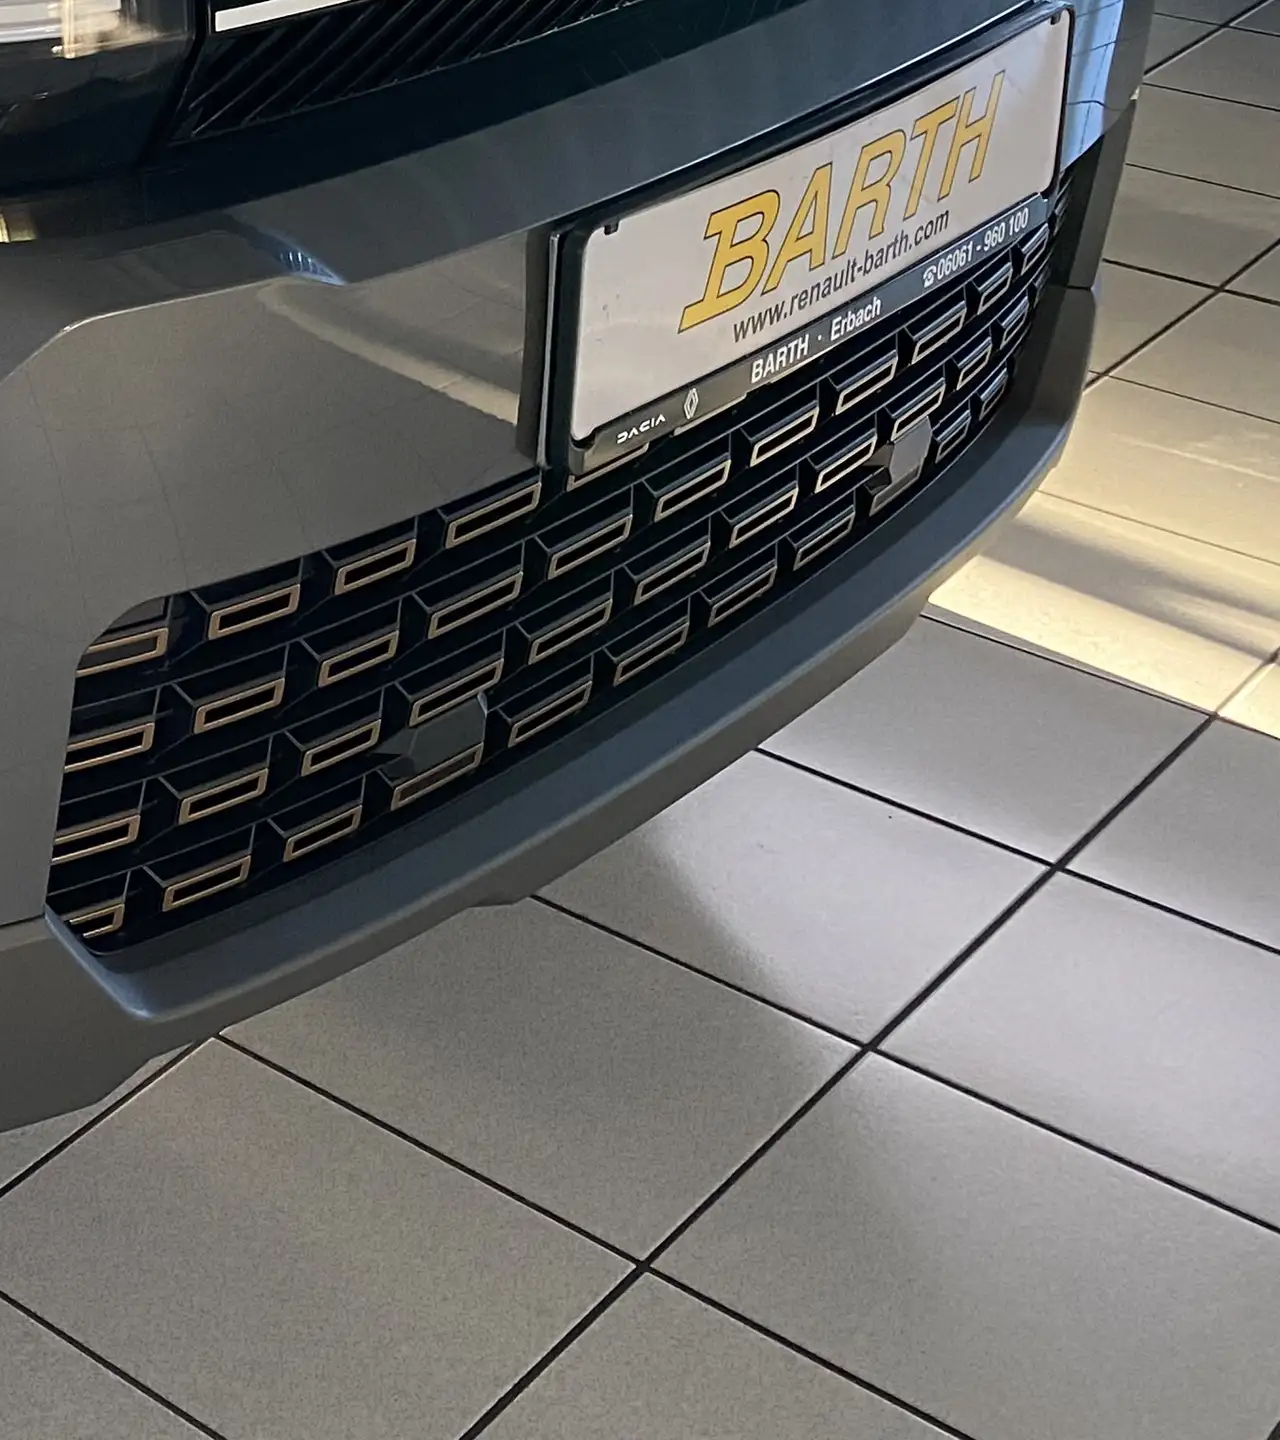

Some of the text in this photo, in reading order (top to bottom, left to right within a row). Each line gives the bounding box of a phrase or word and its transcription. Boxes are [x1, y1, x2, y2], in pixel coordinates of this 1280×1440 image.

[678, 69, 1006, 335] BARTH
[732, 209, 950, 344] www.renault-barth.com
[750, 333, 810, 384] BARTH
[830, 296, 882, 342] Erbach
[936, 240, 974, 281] 06061
[983, 221, 1006, 252] 960
[1008, 207, 1030, 237] 100
[615, 413, 667, 445] DACIA
